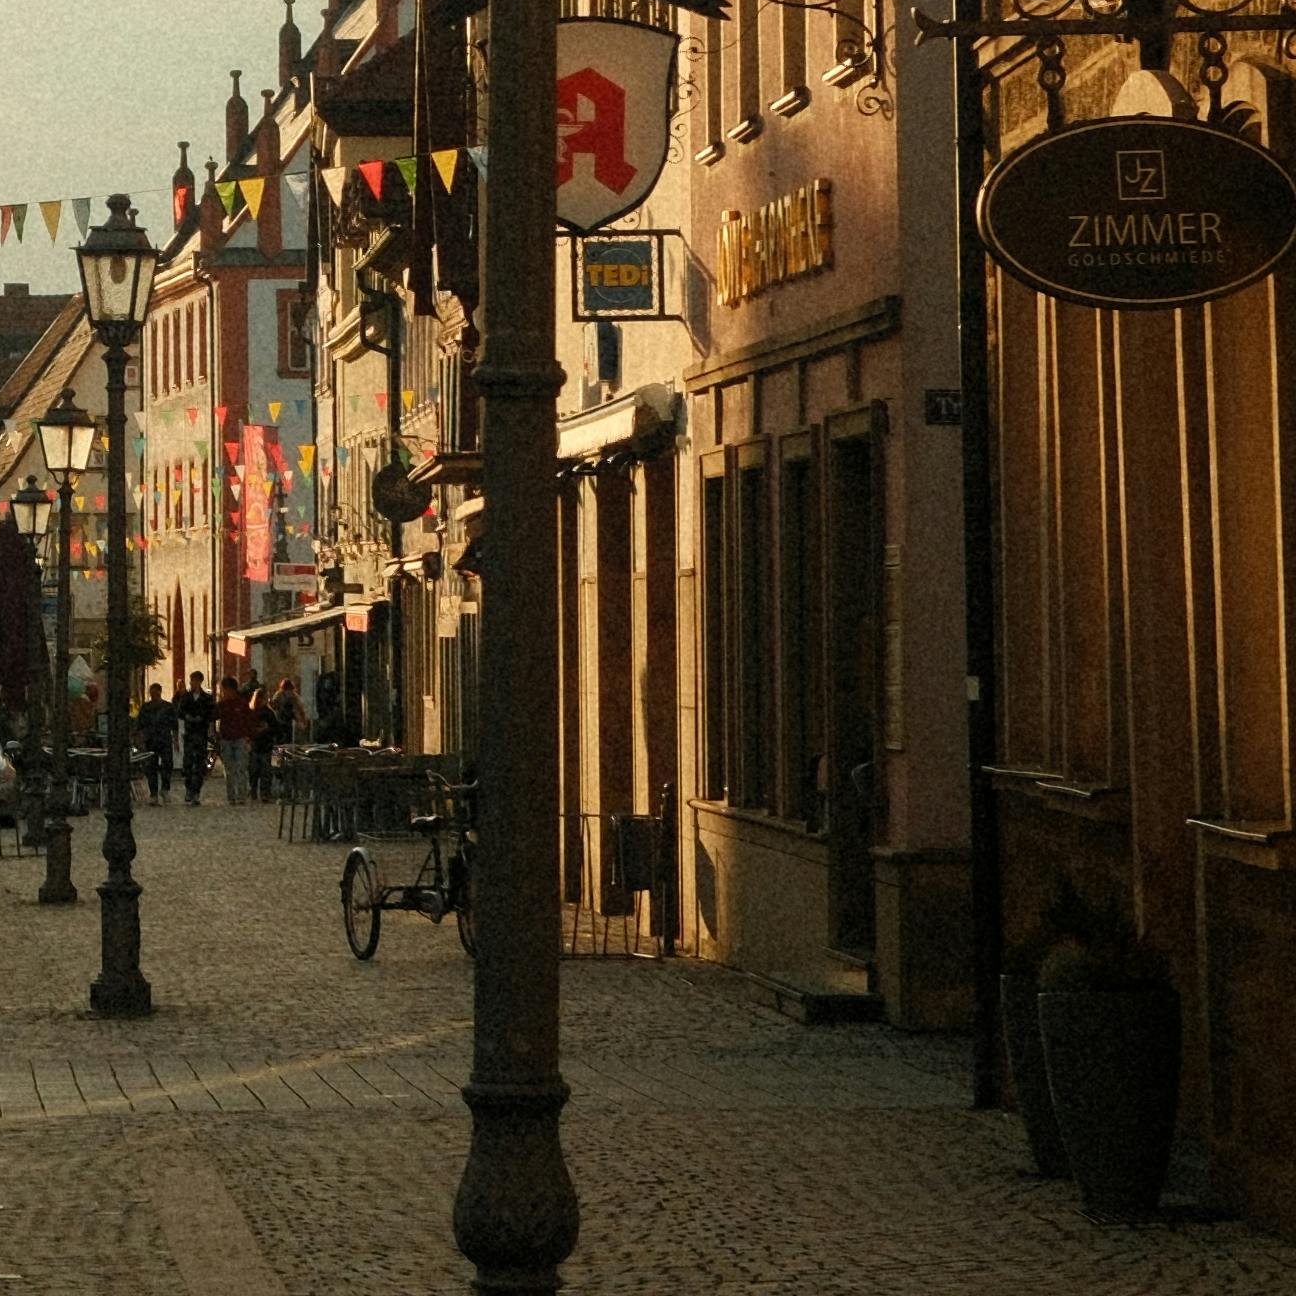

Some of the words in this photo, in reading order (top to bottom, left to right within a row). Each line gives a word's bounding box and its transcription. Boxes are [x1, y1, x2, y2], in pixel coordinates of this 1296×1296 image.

[1067, 211, 1223, 248] ZIMMER
[1067, 249, 1227, 268] GOLDSCHMIEDE
[586, 259, 649, 289] TEDi
